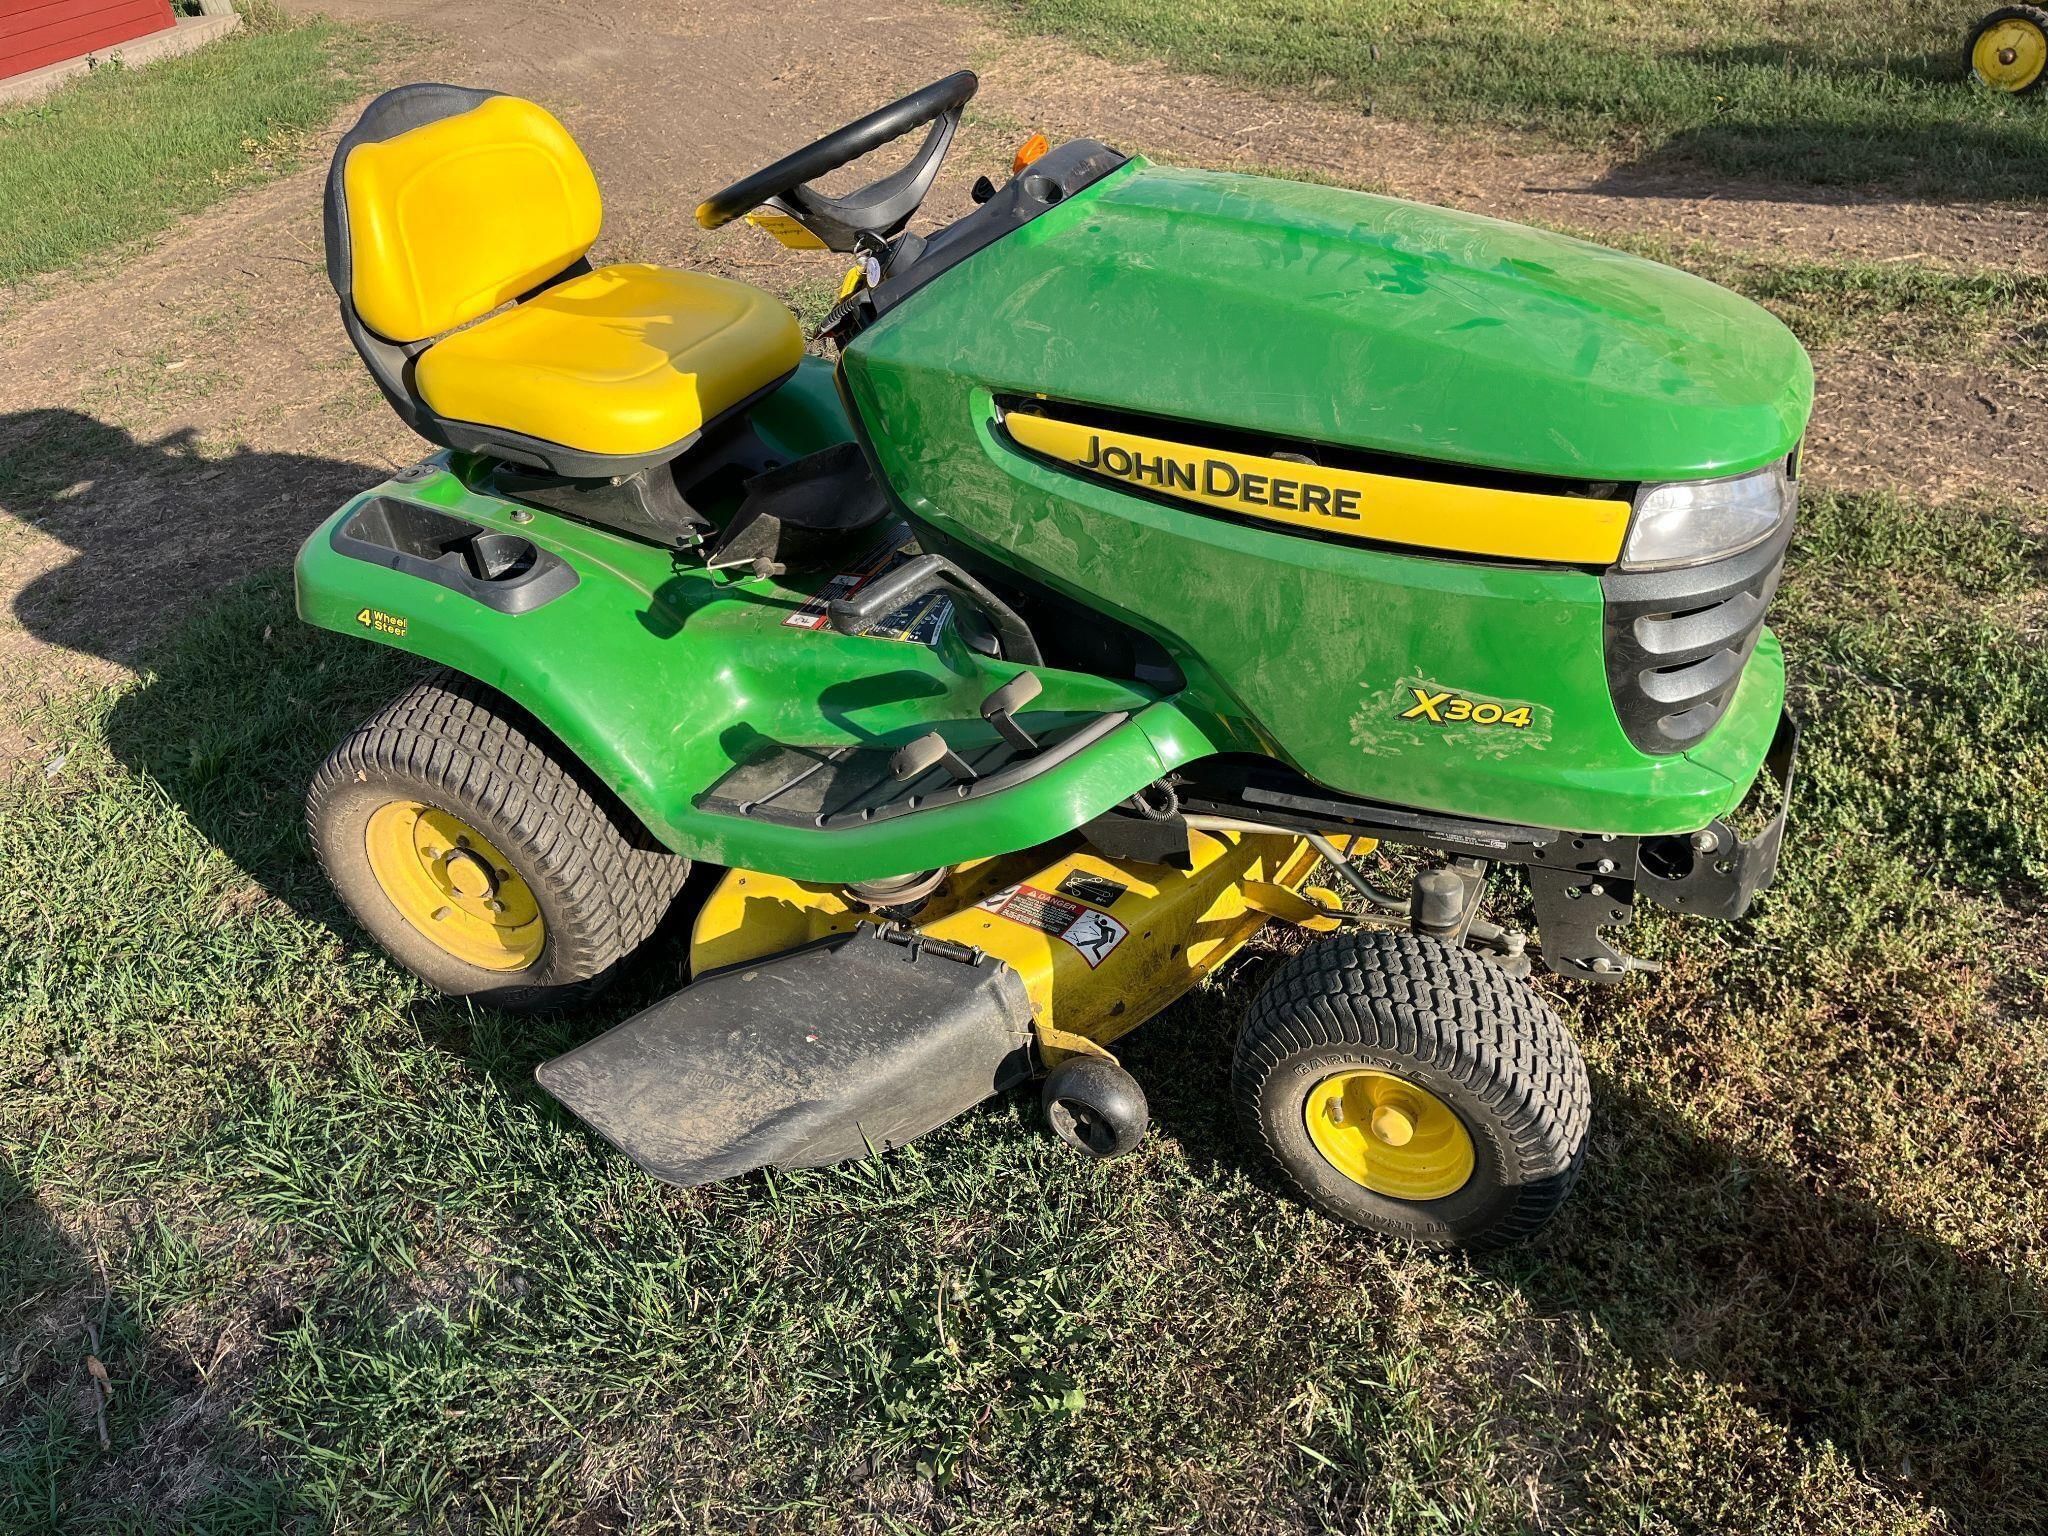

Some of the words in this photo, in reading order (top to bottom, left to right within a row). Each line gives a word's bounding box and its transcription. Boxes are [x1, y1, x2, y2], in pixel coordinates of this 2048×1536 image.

[1078, 435, 1196, 491] JOHN
[1201, 459, 1362, 520] DEERE
[356, 608, 372, 627] 4
[374, 610, 406, 628] Wheel
[375, 620, 406, 636] Steer
[1396, 687, 1534, 729] X304
[1037, 893, 1077, 911] DANGER
[1293, 1054, 1433, 1084] CARLISLE
